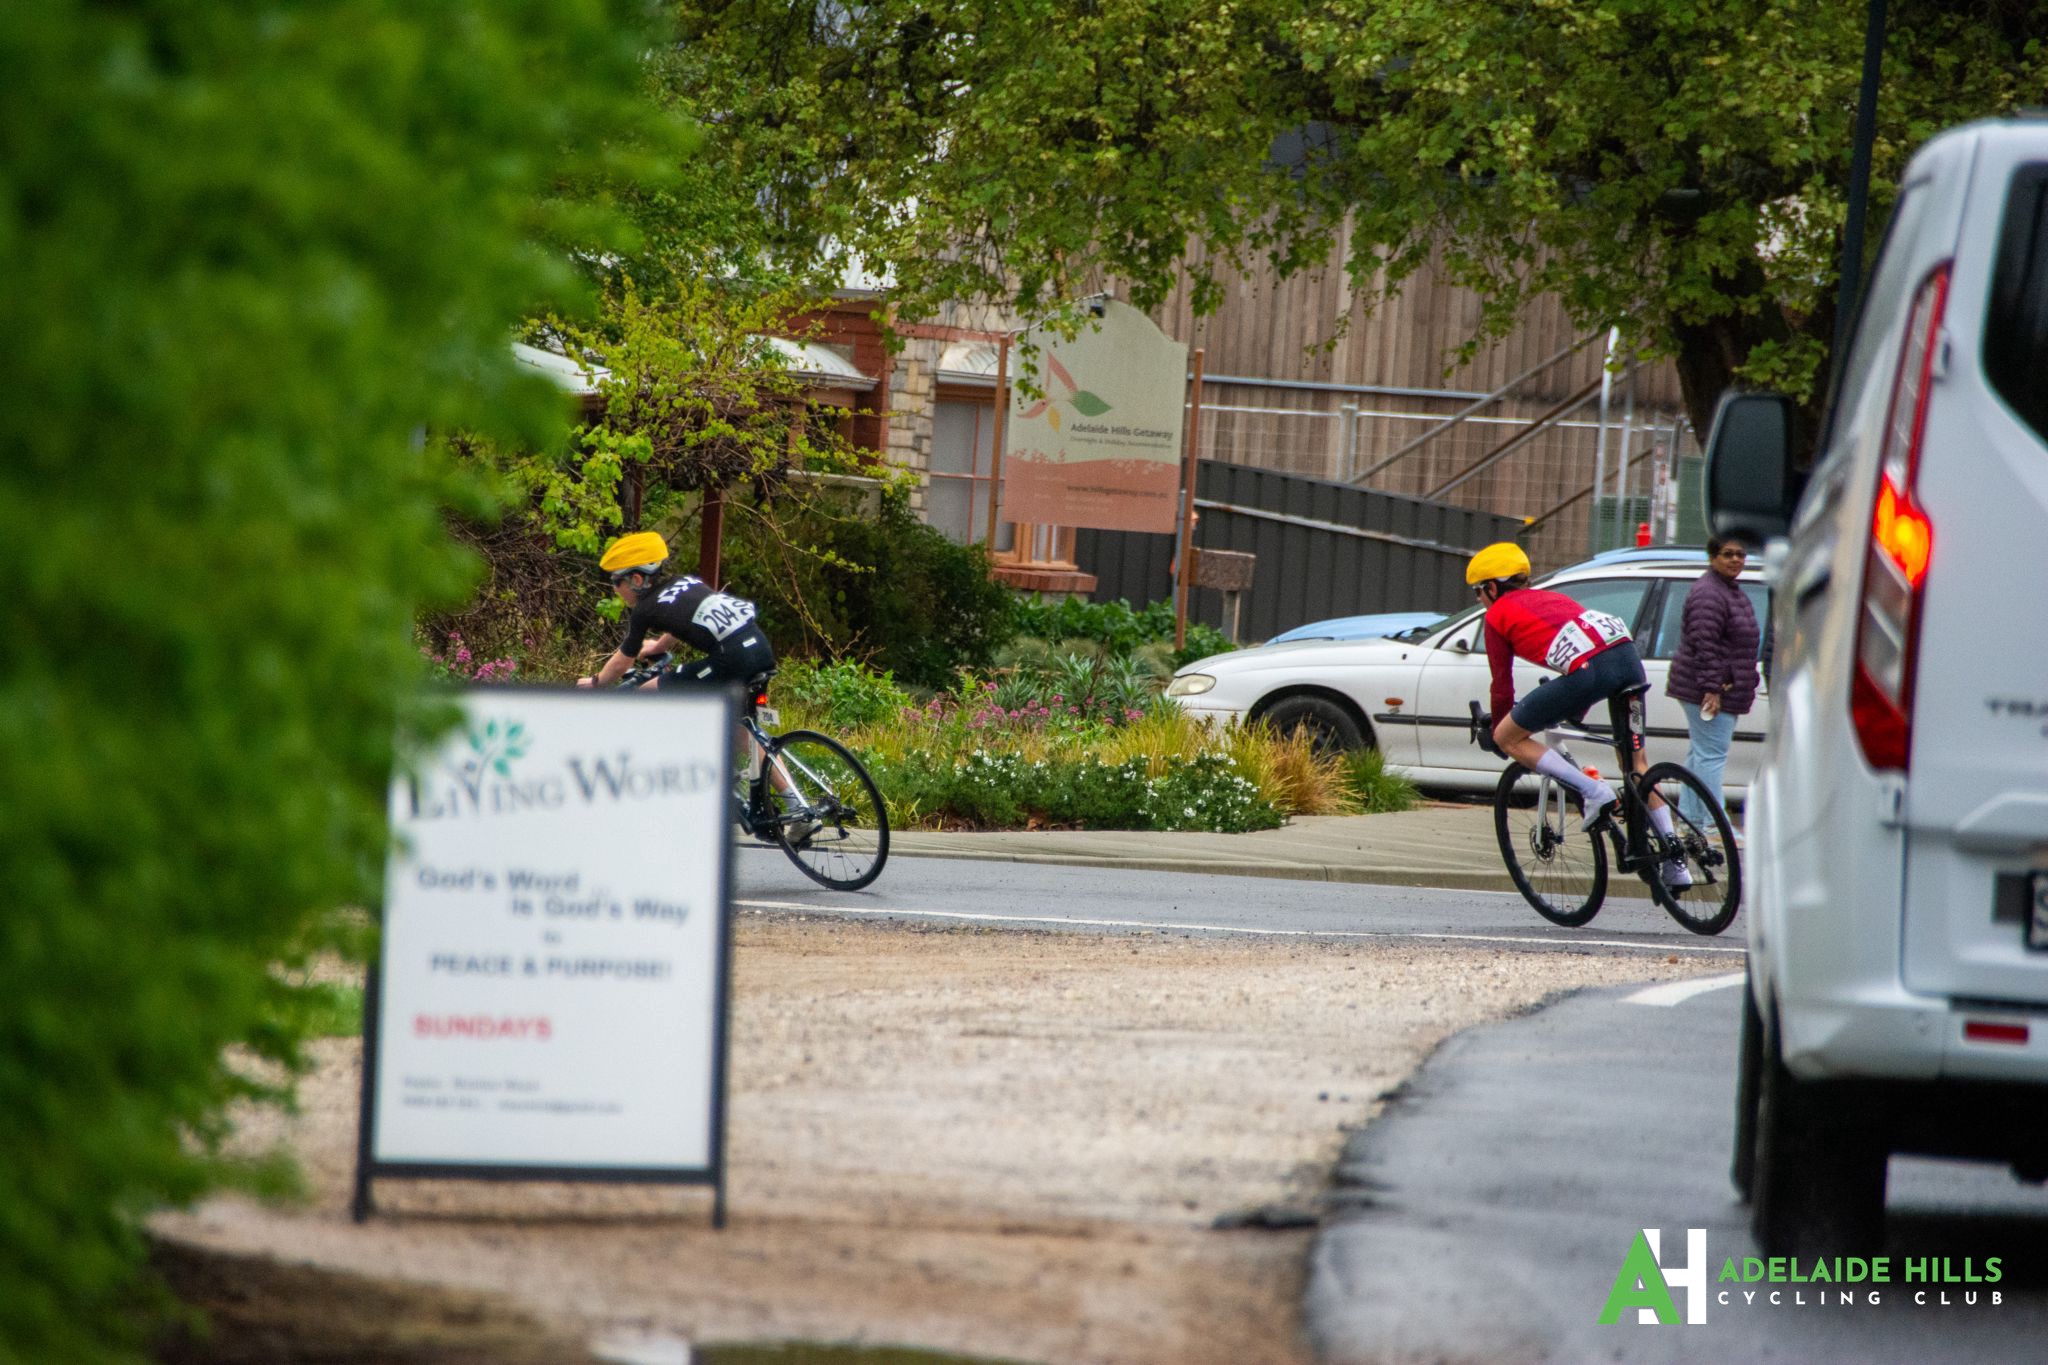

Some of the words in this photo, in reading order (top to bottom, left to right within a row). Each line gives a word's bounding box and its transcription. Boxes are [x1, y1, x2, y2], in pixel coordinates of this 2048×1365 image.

[1071, 423, 1108, 434] Adelaide
[1111, 426, 1131, 436] Hills
[1133, 428, 1173, 441] Getaway
[703, 603, 739, 635] 204
[1597, 616, 1625, 637] 50
[1549, 635, 1581, 668] 507
[416, 867, 497, 892] God's
[507, 869, 581, 893] Word
[544, 898, 622, 919] God's
[632, 898, 690, 926] Way
[430, 954, 513, 976] PEACE
[522, 957, 538, 977] &
[412, 1013, 553, 1040] SUNDAYS
